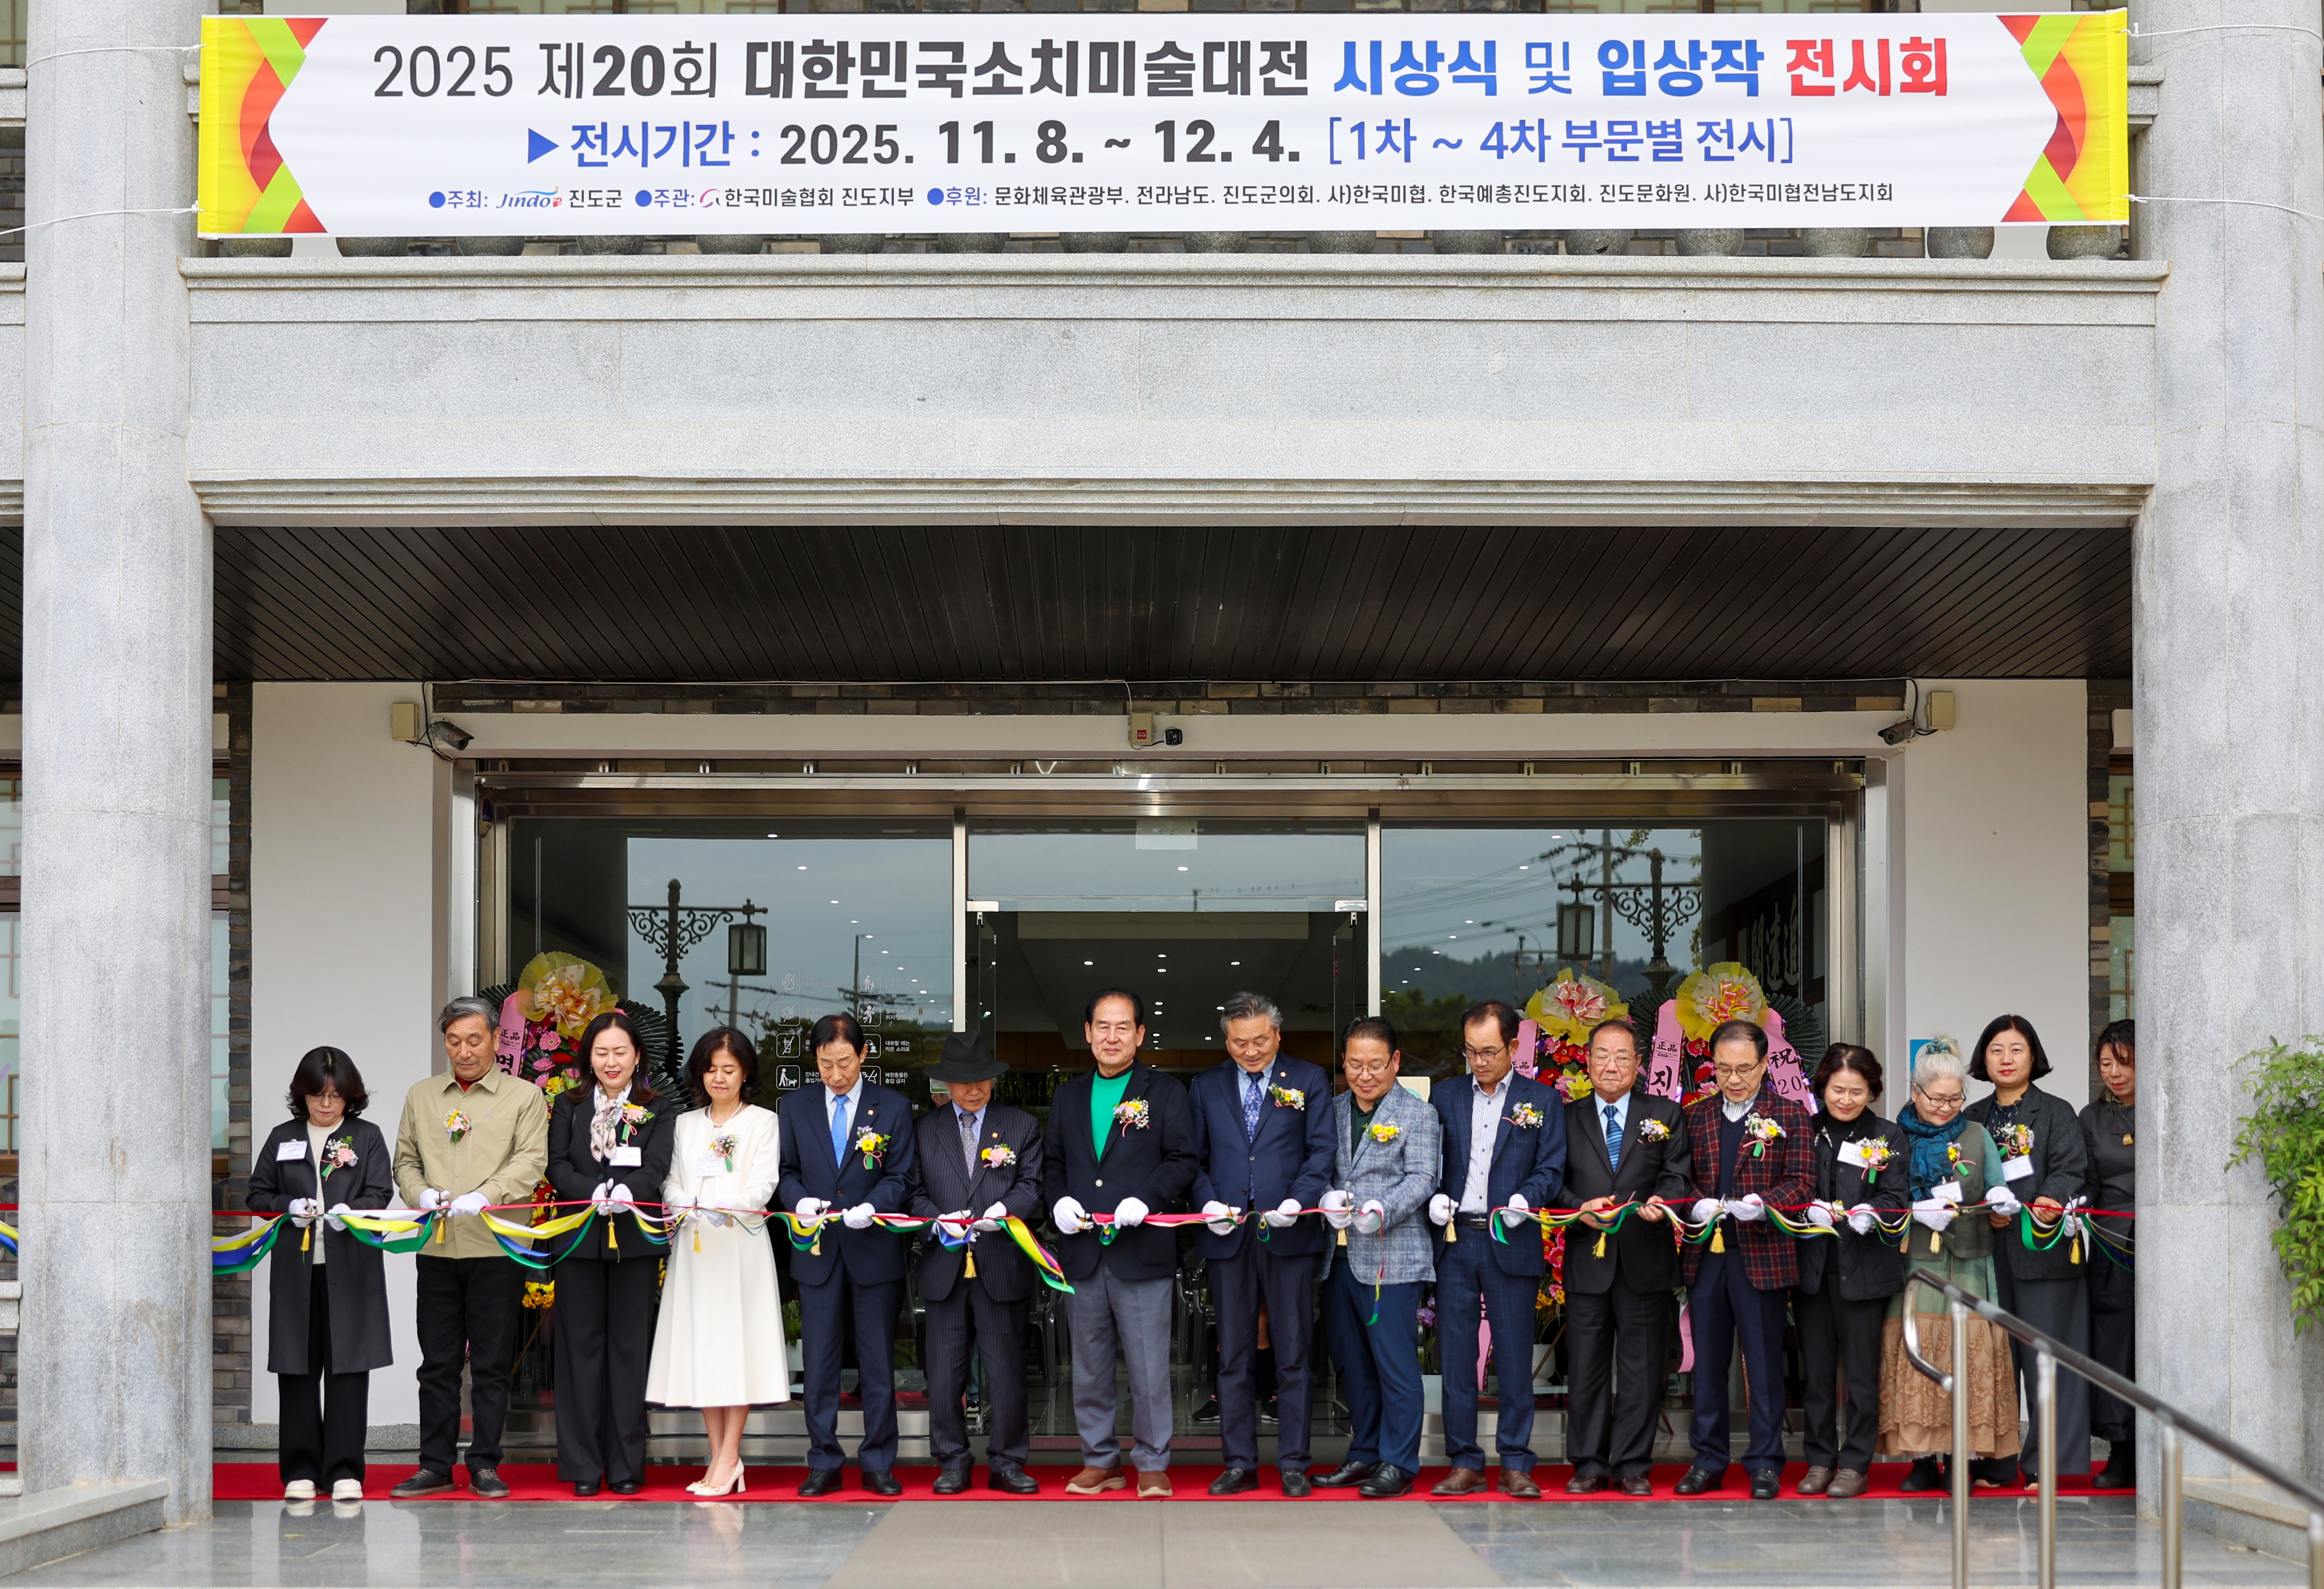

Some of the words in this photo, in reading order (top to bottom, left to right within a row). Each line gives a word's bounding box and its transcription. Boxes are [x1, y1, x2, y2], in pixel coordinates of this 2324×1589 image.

[374, 46, 512, 97] 2025
[538, 40, 717, 99] 제20회
[745, 39, 1308, 99] 대한민국소치미술대전
[1334, 40, 1497, 97] 시상식
[1526, 41, 1572, 94] 및
[1597, 39, 1764, 97] 입상작
[1786, 37, 1948, 97] 전시회
[571, 120, 735, 167] 전시기간
[780, 124, 914, 165] 2025.
[939, 121, 1015, 164] 11.
[1036, 119, 1083, 164] 8.
[1155, 120, 1232, 162] 12.
[1252, 120, 1300, 162] 4.
[1329, 117, 1417, 165] [1차
[1480, 118, 1551, 163] 4차
[1562, 118, 1684, 163] 부문별
[1697, 118, 1793, 164] 전시]
[446, 190, 487, 208] 주최:
[496, 192, 551, 208] Jindo
[569, 190, 622, 208] 진도군
[653, 189, 695, 207] 주관:
[725, 187, 833, 207] 한국미술협회
[842, 187, 914, 206] 진도지부
[946, 187, 987, 206] 후원:
[995, 186, 1129, 206] 문화체육관광부.
[1137, 186, 1215, 205] 전라남도.
[1223, 185, 1320, 204] 진도군의회.
[1328, 184, 1431, 205] 사)한국미협.
[1439, 184, 1592, 204] 한국예총진도지회.
[1600, 184, 1696, 203] 진도문화원.
[1704, 183, 1892, 203] 사)한국미협전남도지회
[500, 1029, 520, 1040] 正品
[1656, 1041, 1678, 1052] 正品
[1769, 1048, 1798, 1069] 祝
[1778, 1076, 1802, 1095] 20
